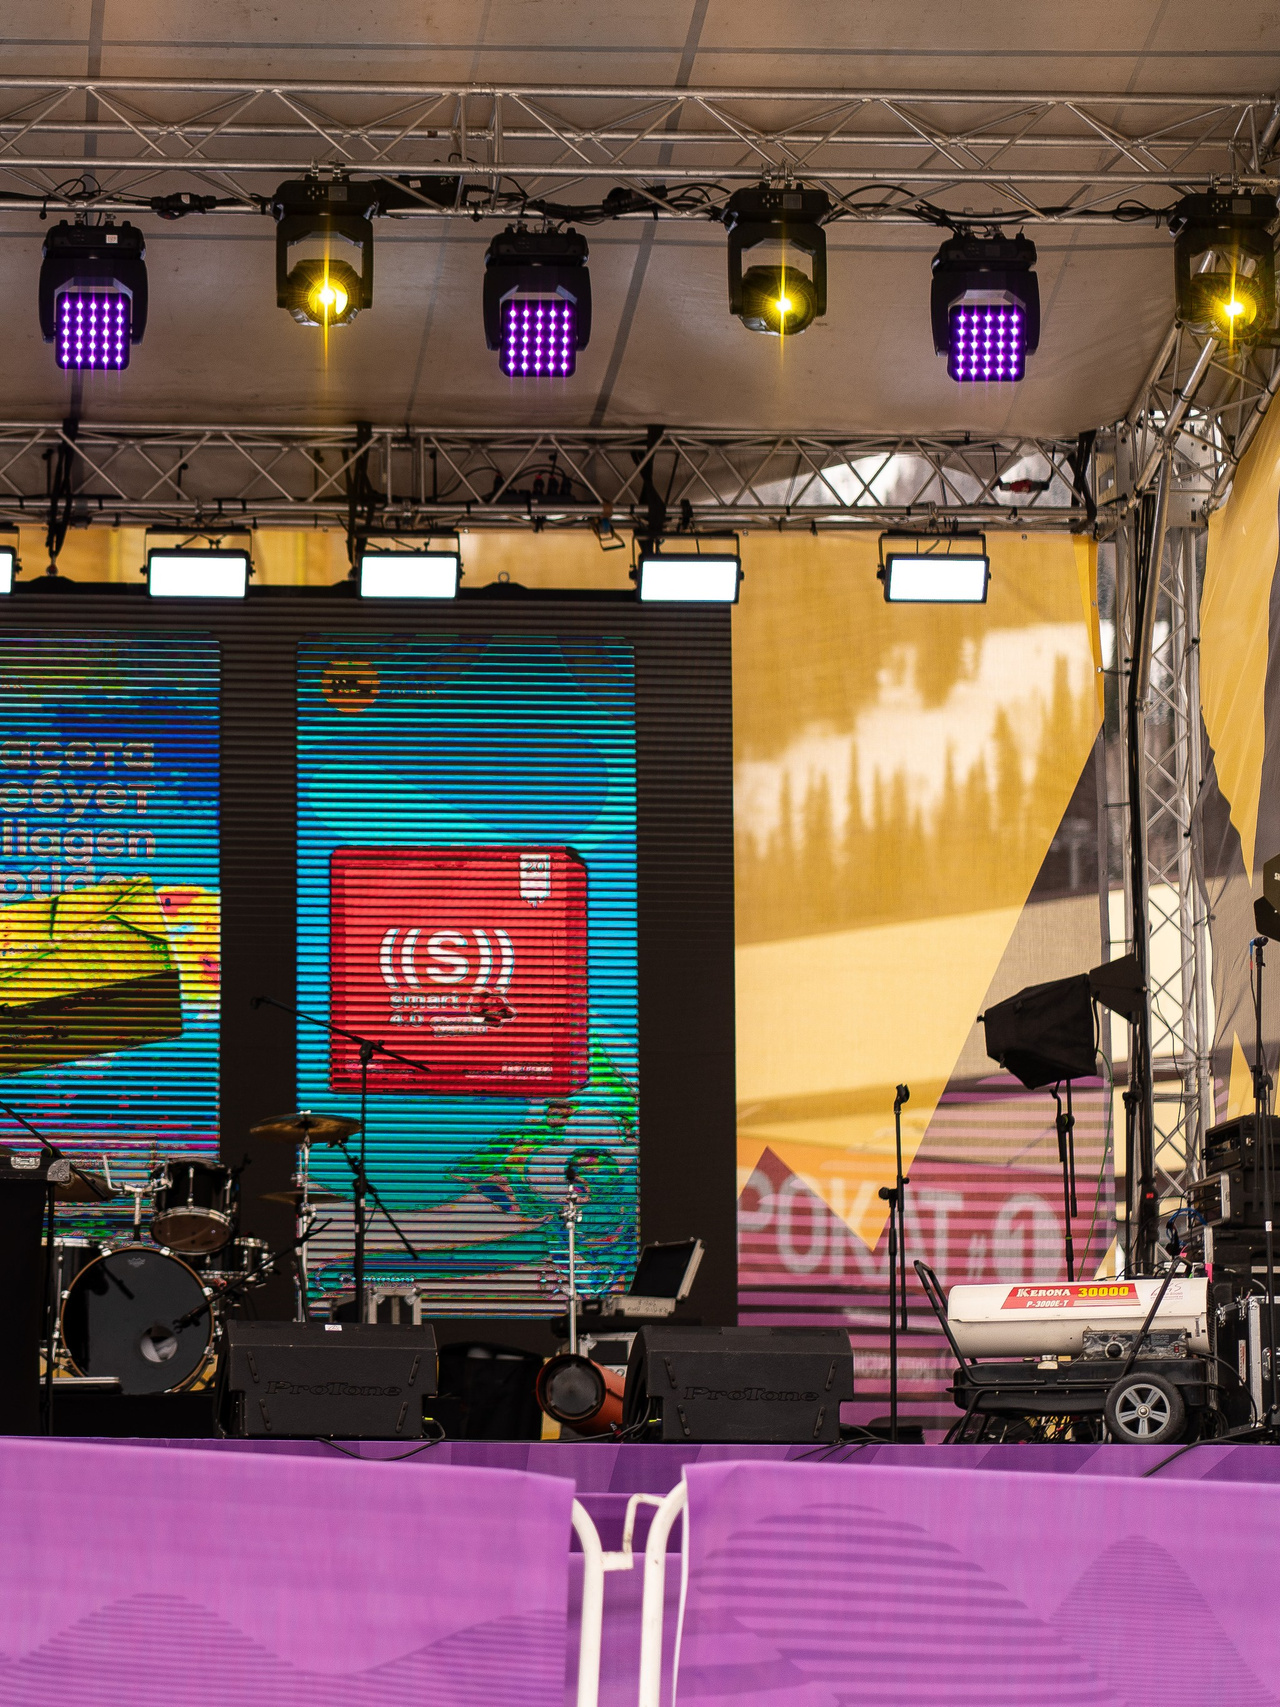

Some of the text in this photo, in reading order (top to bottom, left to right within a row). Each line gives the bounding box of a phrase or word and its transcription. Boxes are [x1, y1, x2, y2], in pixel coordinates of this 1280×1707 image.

[389, 991, 460, 1009] smart
[1016, 1286, 1129, 1298] KERONA 30000
[265, 1381, 403, 1397] ProTone
[684, 1386, 820, 1402] ProTone
